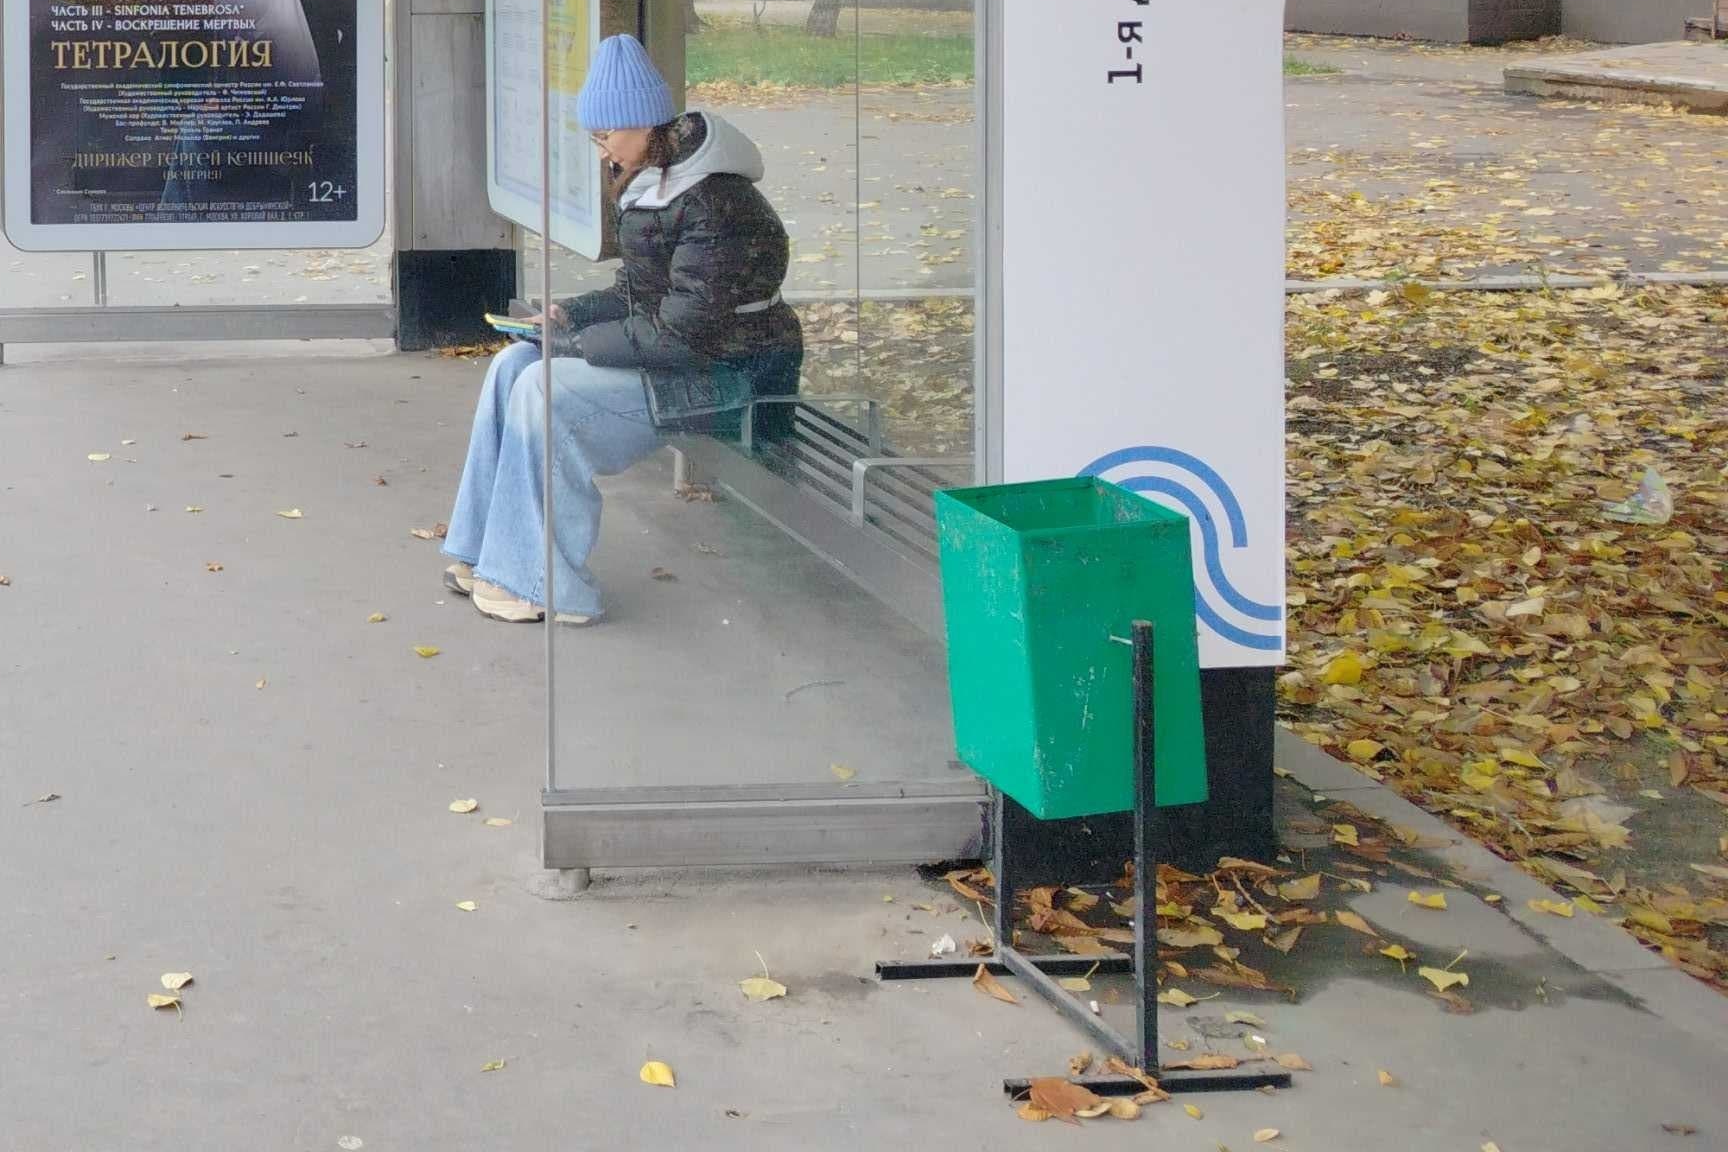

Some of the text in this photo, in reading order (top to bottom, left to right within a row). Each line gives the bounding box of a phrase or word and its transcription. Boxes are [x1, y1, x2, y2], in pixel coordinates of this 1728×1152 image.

[51, 6, 88, 16] ЧАСТЬ
[91, 6, 103, 16] III
[114, 5, 170, 16] SINFONIA
[51, 20, 88, 31] ЧАСТЬ
[92, 20, 103, 30] IV
[115, 19, 200, 30] ВОСКРЕШЕНИЕ
[203, 19, 256, 30] МЕРТВЫХ
[51, 40, 272, 70] ТЕТРАЛОГИЯ
[1107, 21, 1143, 84] 1-я
[308, 181, 347, 202] 12+
